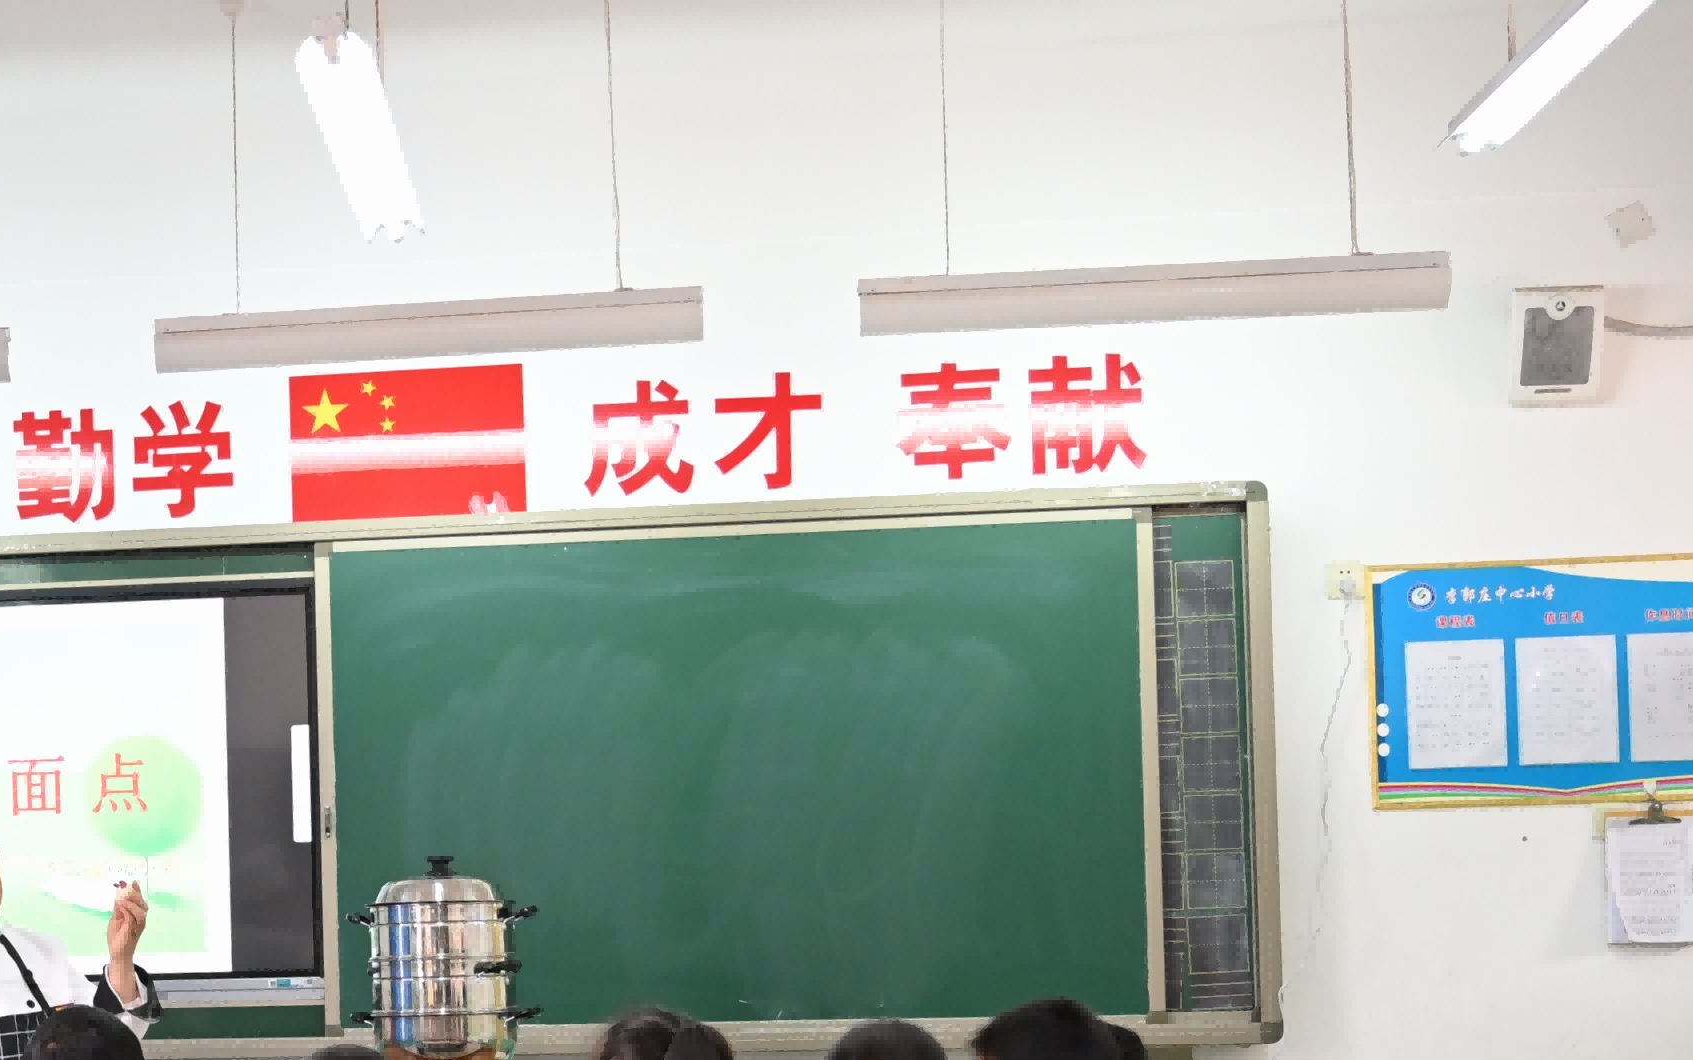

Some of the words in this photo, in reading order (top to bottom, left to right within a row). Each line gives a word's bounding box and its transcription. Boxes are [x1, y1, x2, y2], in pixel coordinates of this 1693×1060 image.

[13, 400, 236, 523] 勤学
[583, 371, 825, 498] 成才
[896, 353, 1148, 480] 奉献
